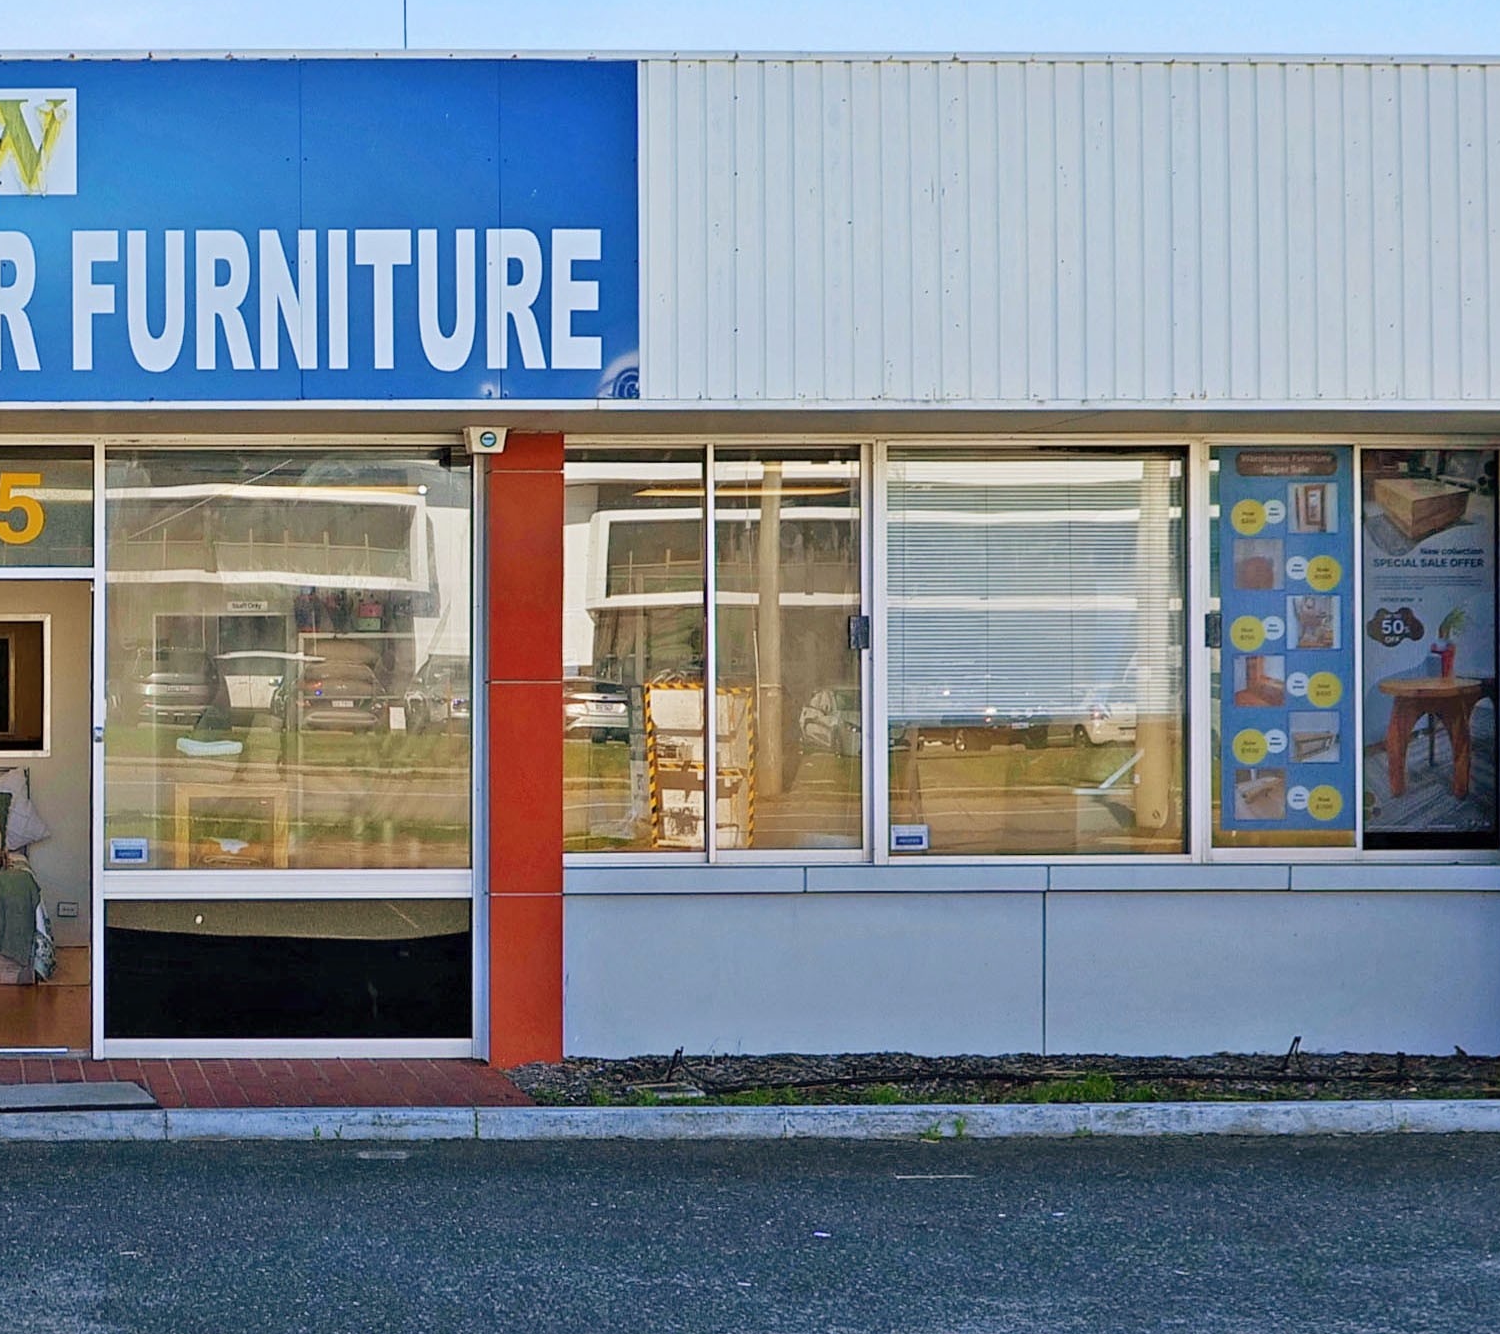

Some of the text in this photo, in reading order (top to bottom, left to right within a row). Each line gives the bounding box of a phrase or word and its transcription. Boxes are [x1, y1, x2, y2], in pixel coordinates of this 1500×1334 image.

[72, 227, 603, 371] FURNITURE
[1292, 454, 1334, 463] Furniture
[1290, 465, 1310, 473] Sale
[1373, 558, 1485, 567] SPECIAL SALE OFFER
